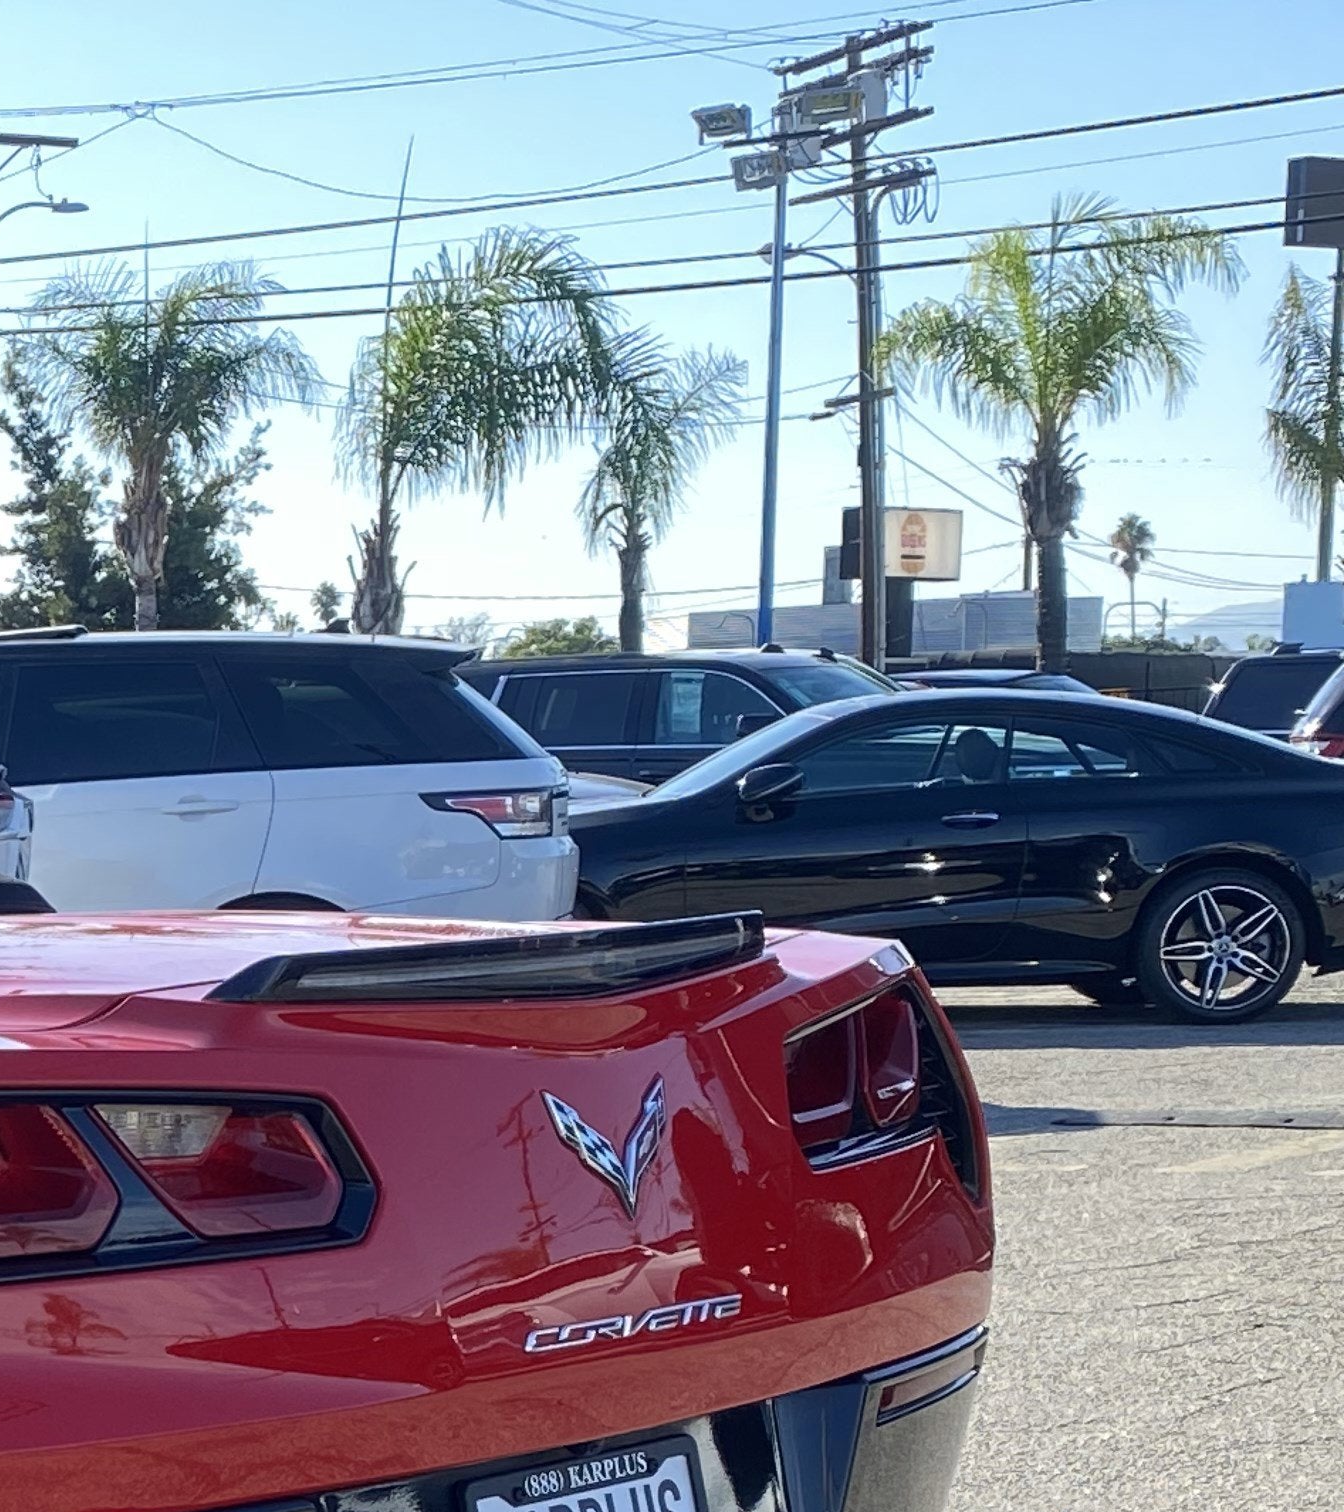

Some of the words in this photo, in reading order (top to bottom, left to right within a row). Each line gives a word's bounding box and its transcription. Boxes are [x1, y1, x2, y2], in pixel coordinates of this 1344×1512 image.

[524, 1293, 743, 1353] CORVETTE
[524, 1471, 563, 1498] (888)
[568, 1452, 648, 1489] KARPLUS
